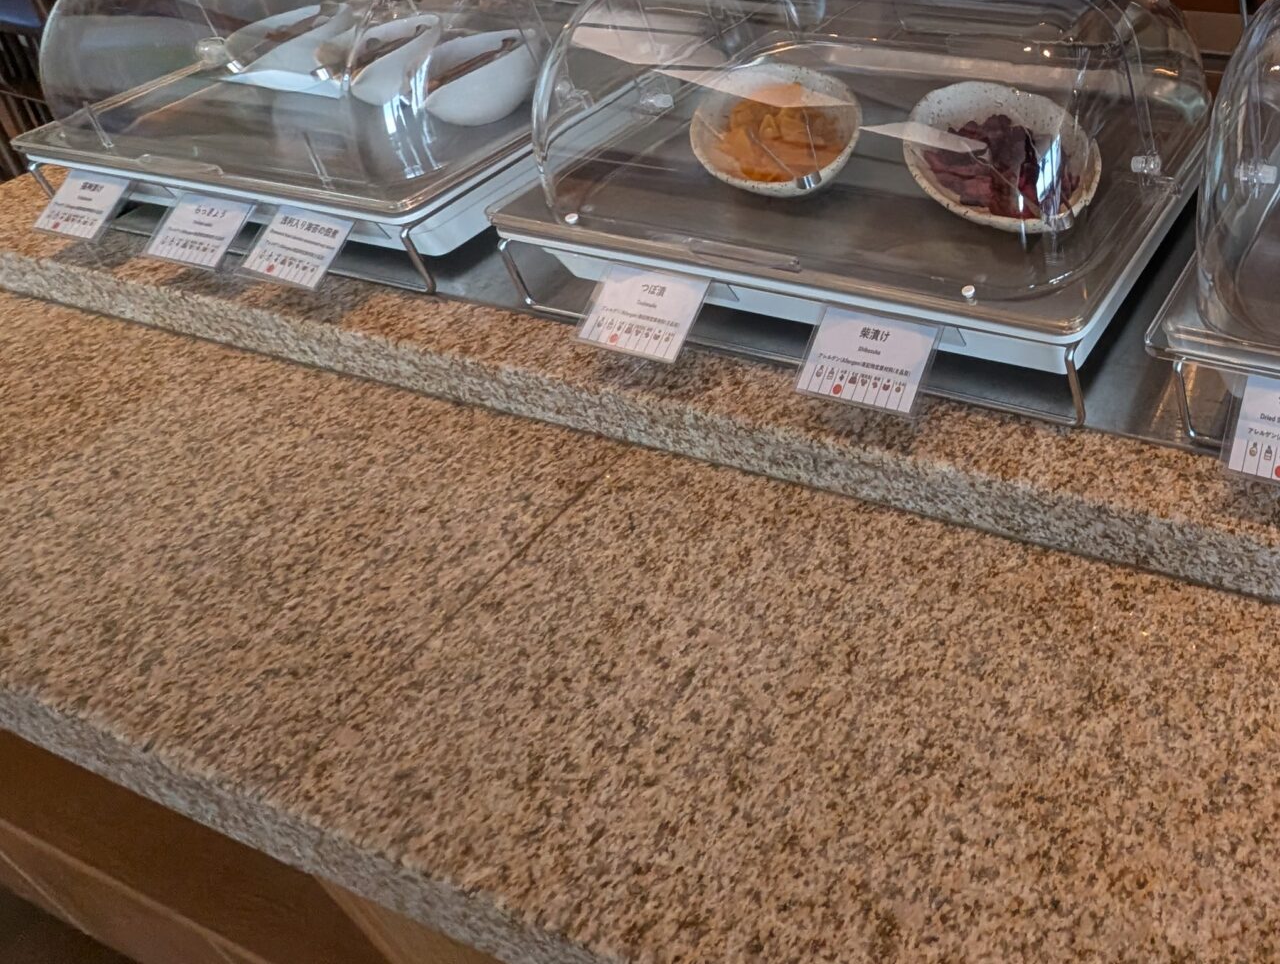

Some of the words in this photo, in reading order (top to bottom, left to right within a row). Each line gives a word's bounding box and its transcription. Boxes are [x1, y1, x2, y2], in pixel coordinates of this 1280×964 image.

[859, 326, 890, 342] 柴漬け
[1260, 413, 1276, 424] Dried
